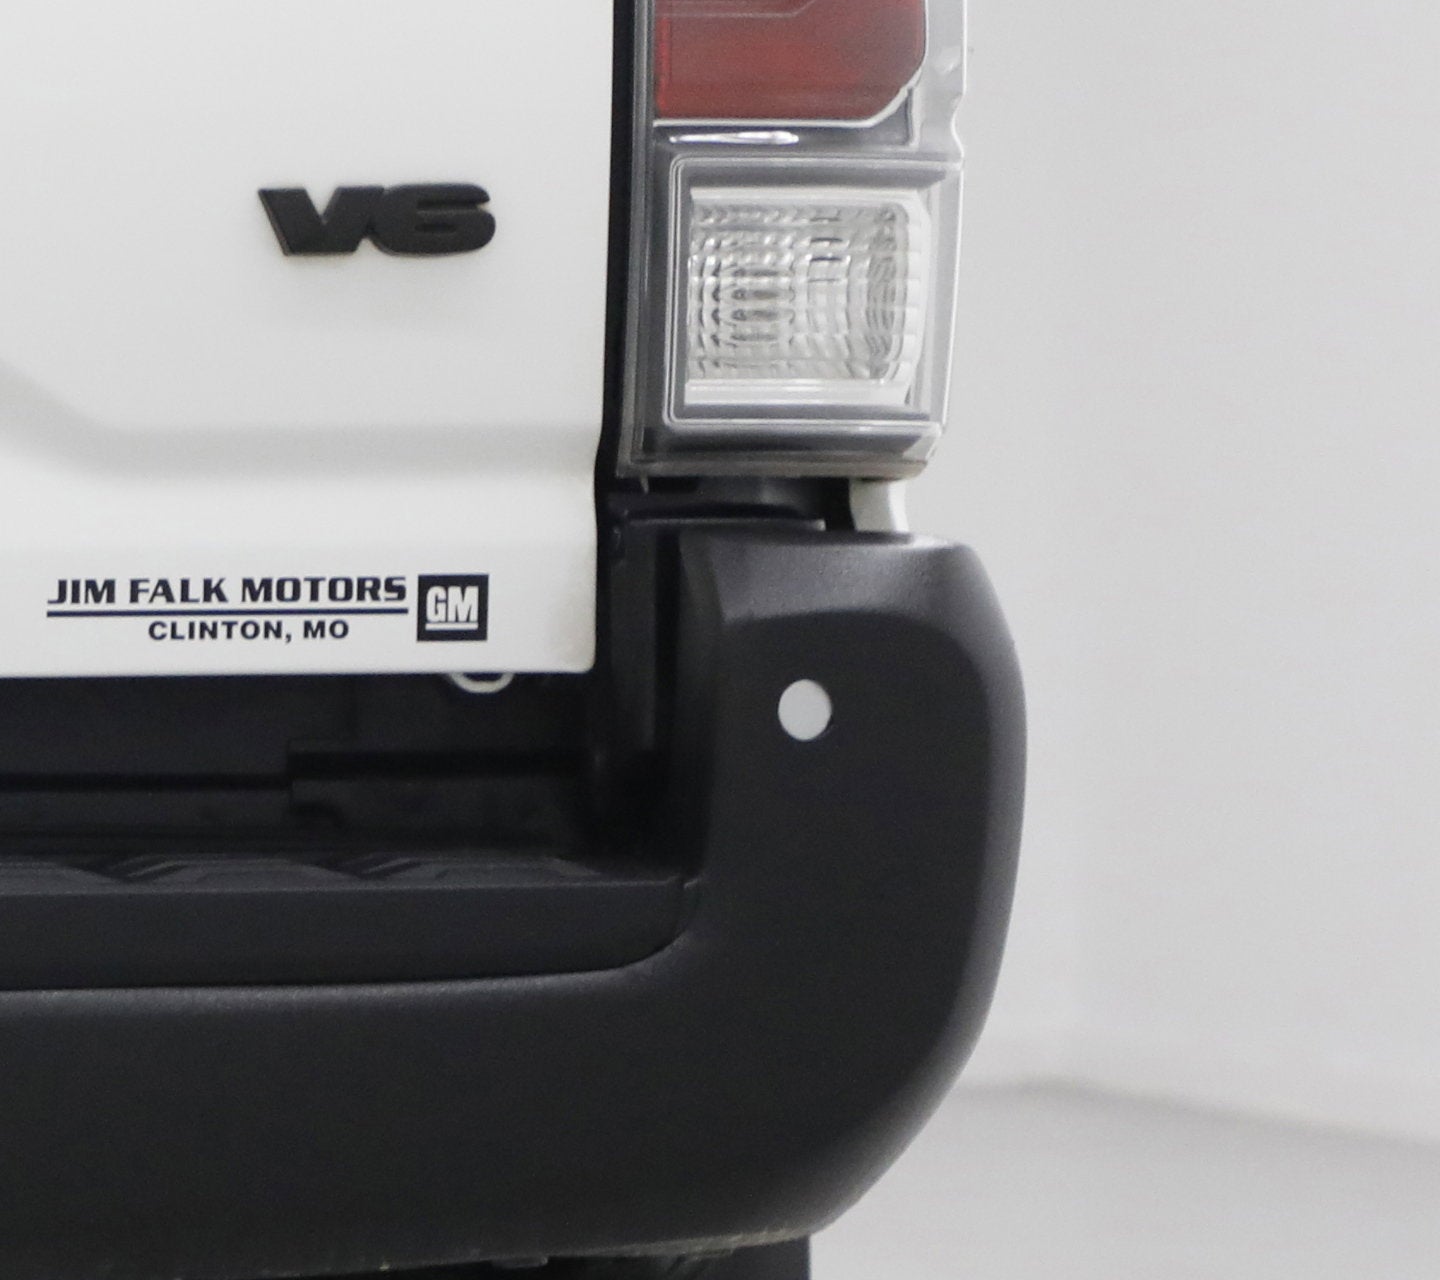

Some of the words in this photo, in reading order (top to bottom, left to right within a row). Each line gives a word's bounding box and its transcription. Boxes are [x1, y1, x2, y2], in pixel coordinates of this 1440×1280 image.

[257, 182, 496, 258] V6
[47, 579, 116, 605] JIM
[129, 578, 228, 604] FALK
[241, 576, 407, 603] MOTORS
[425, 585, 479, 625] GM
[148, 620, 292, 643] CLINTON,
[303, 619, 350, 639] MO
